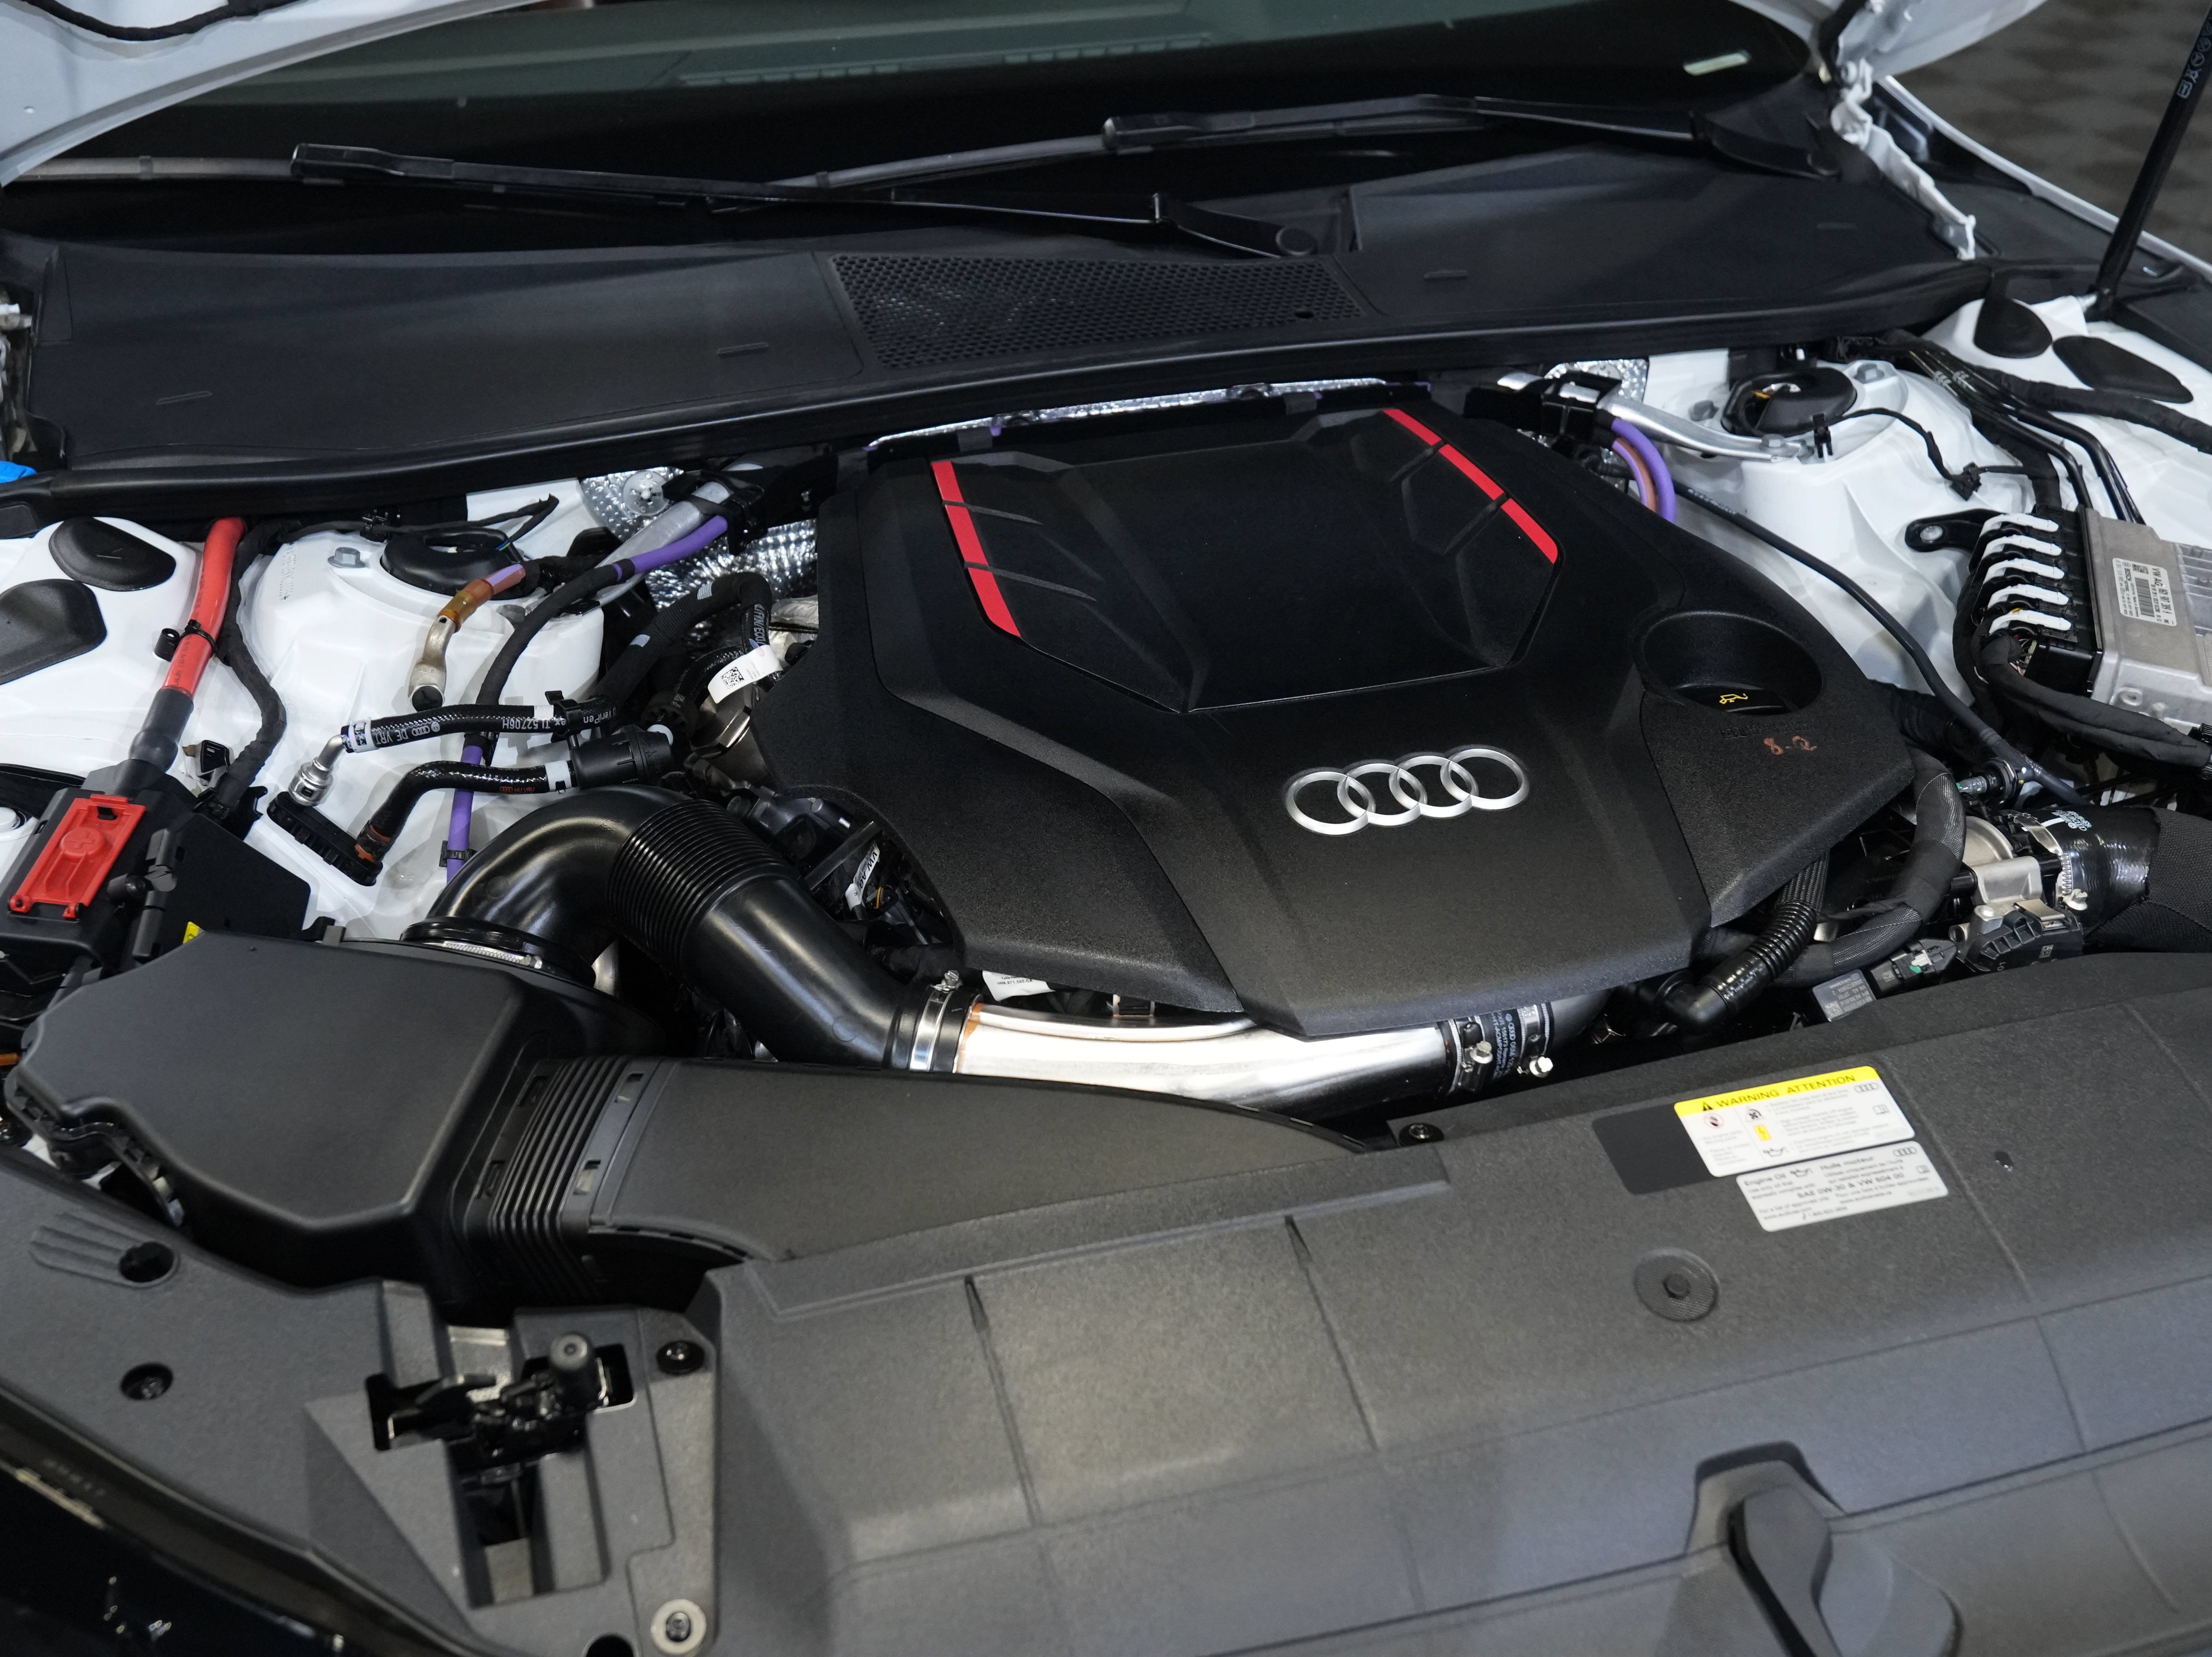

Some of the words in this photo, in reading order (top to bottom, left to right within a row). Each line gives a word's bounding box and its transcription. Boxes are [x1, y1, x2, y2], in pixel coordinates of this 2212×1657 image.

[2152, 567, 2161, 577] VW
[2153, 578, 2163, 586] AG
[867, 851, 877, 871] VW
[859, 872, 867, 888] AG
[1716, 1089, 1780, 1107] WARNING
[1785, 1075, 1856, 1093] ATTENTION
[1743, 1176, 1773, 1187] Engine
[1796, 1190, 1816, 1198] SAE
[1856, 1178, 1875, 1186] VW
